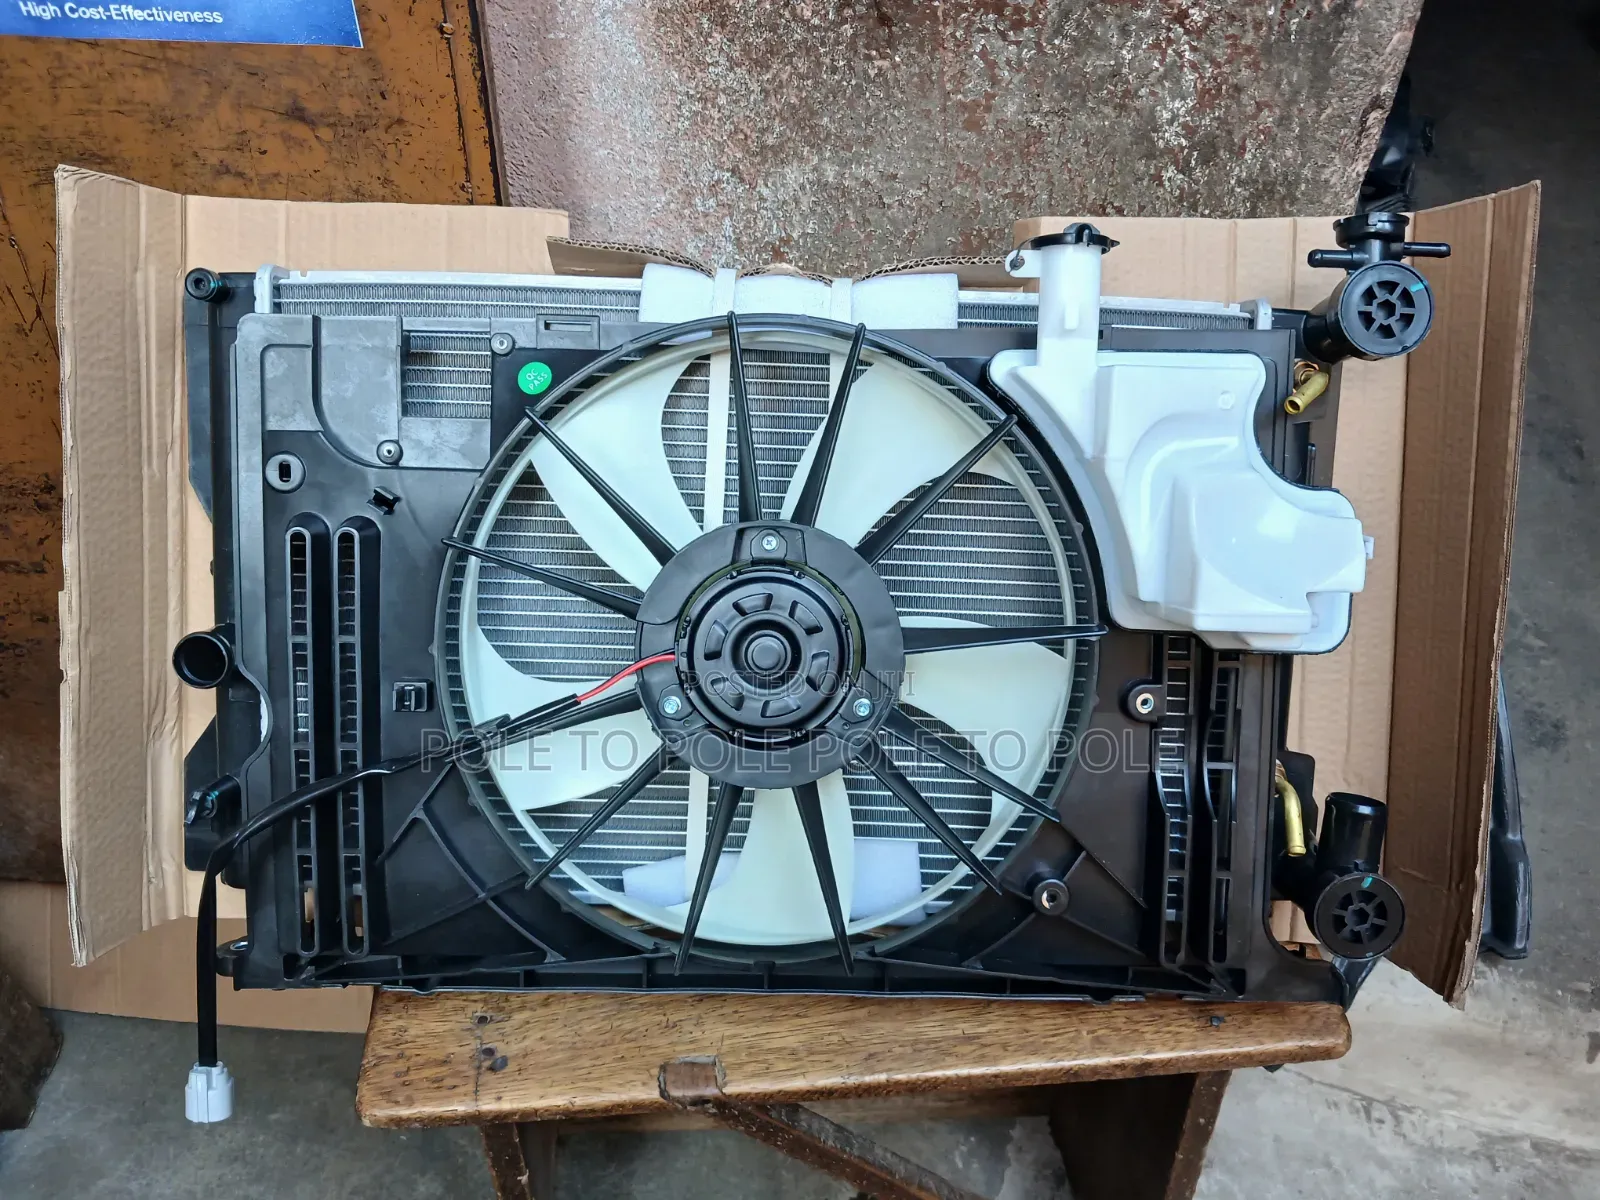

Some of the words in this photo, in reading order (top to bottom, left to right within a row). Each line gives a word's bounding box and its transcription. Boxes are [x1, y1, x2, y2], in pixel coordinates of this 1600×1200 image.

[19, 1, 61, 20] High
[64, 2, 223, 24] Cost-Effectiveness
[525, 368, 538, 381] QC
[528, 372, 548, 390] PASS
